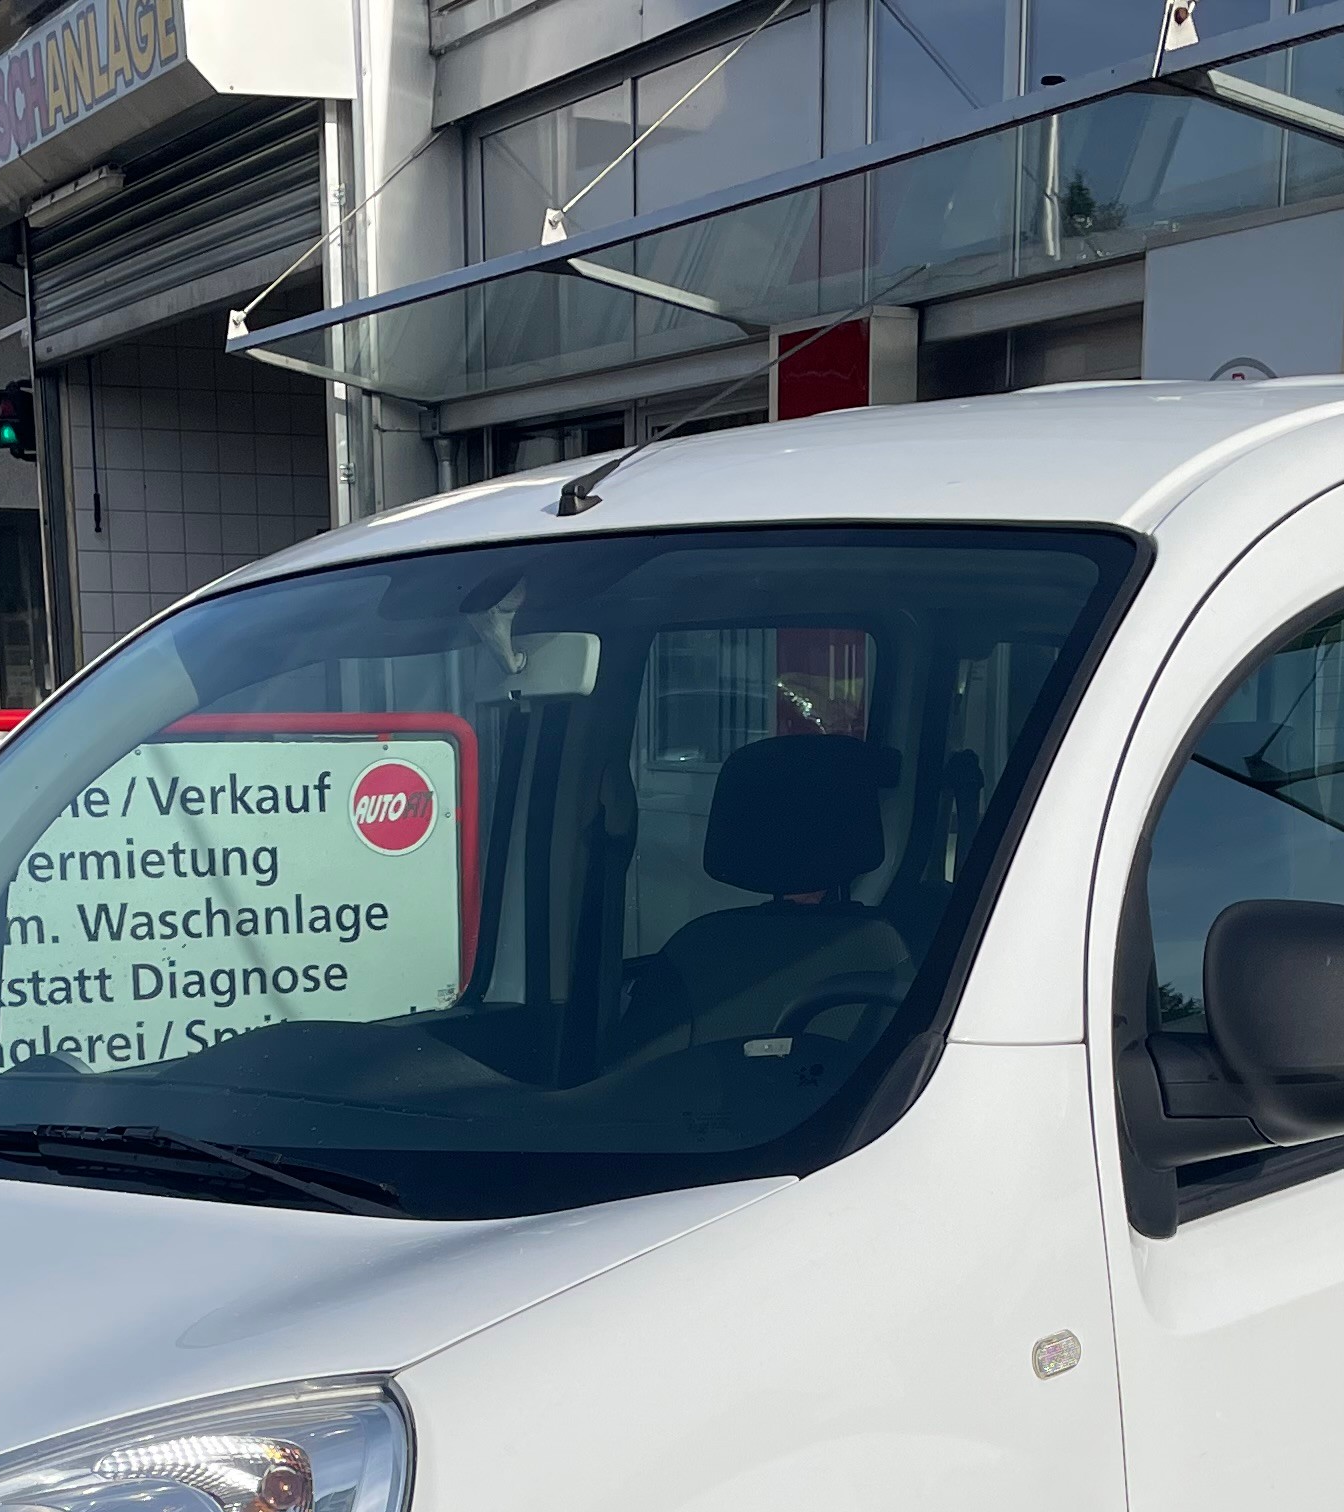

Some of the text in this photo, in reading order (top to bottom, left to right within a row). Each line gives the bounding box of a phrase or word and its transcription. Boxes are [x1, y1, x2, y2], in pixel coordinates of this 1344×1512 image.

[147, 771, 331, 817] Verkauf
[76, 893, 389, 943] Waschanlage
[131, 960, 348, 1008] Diagnose
